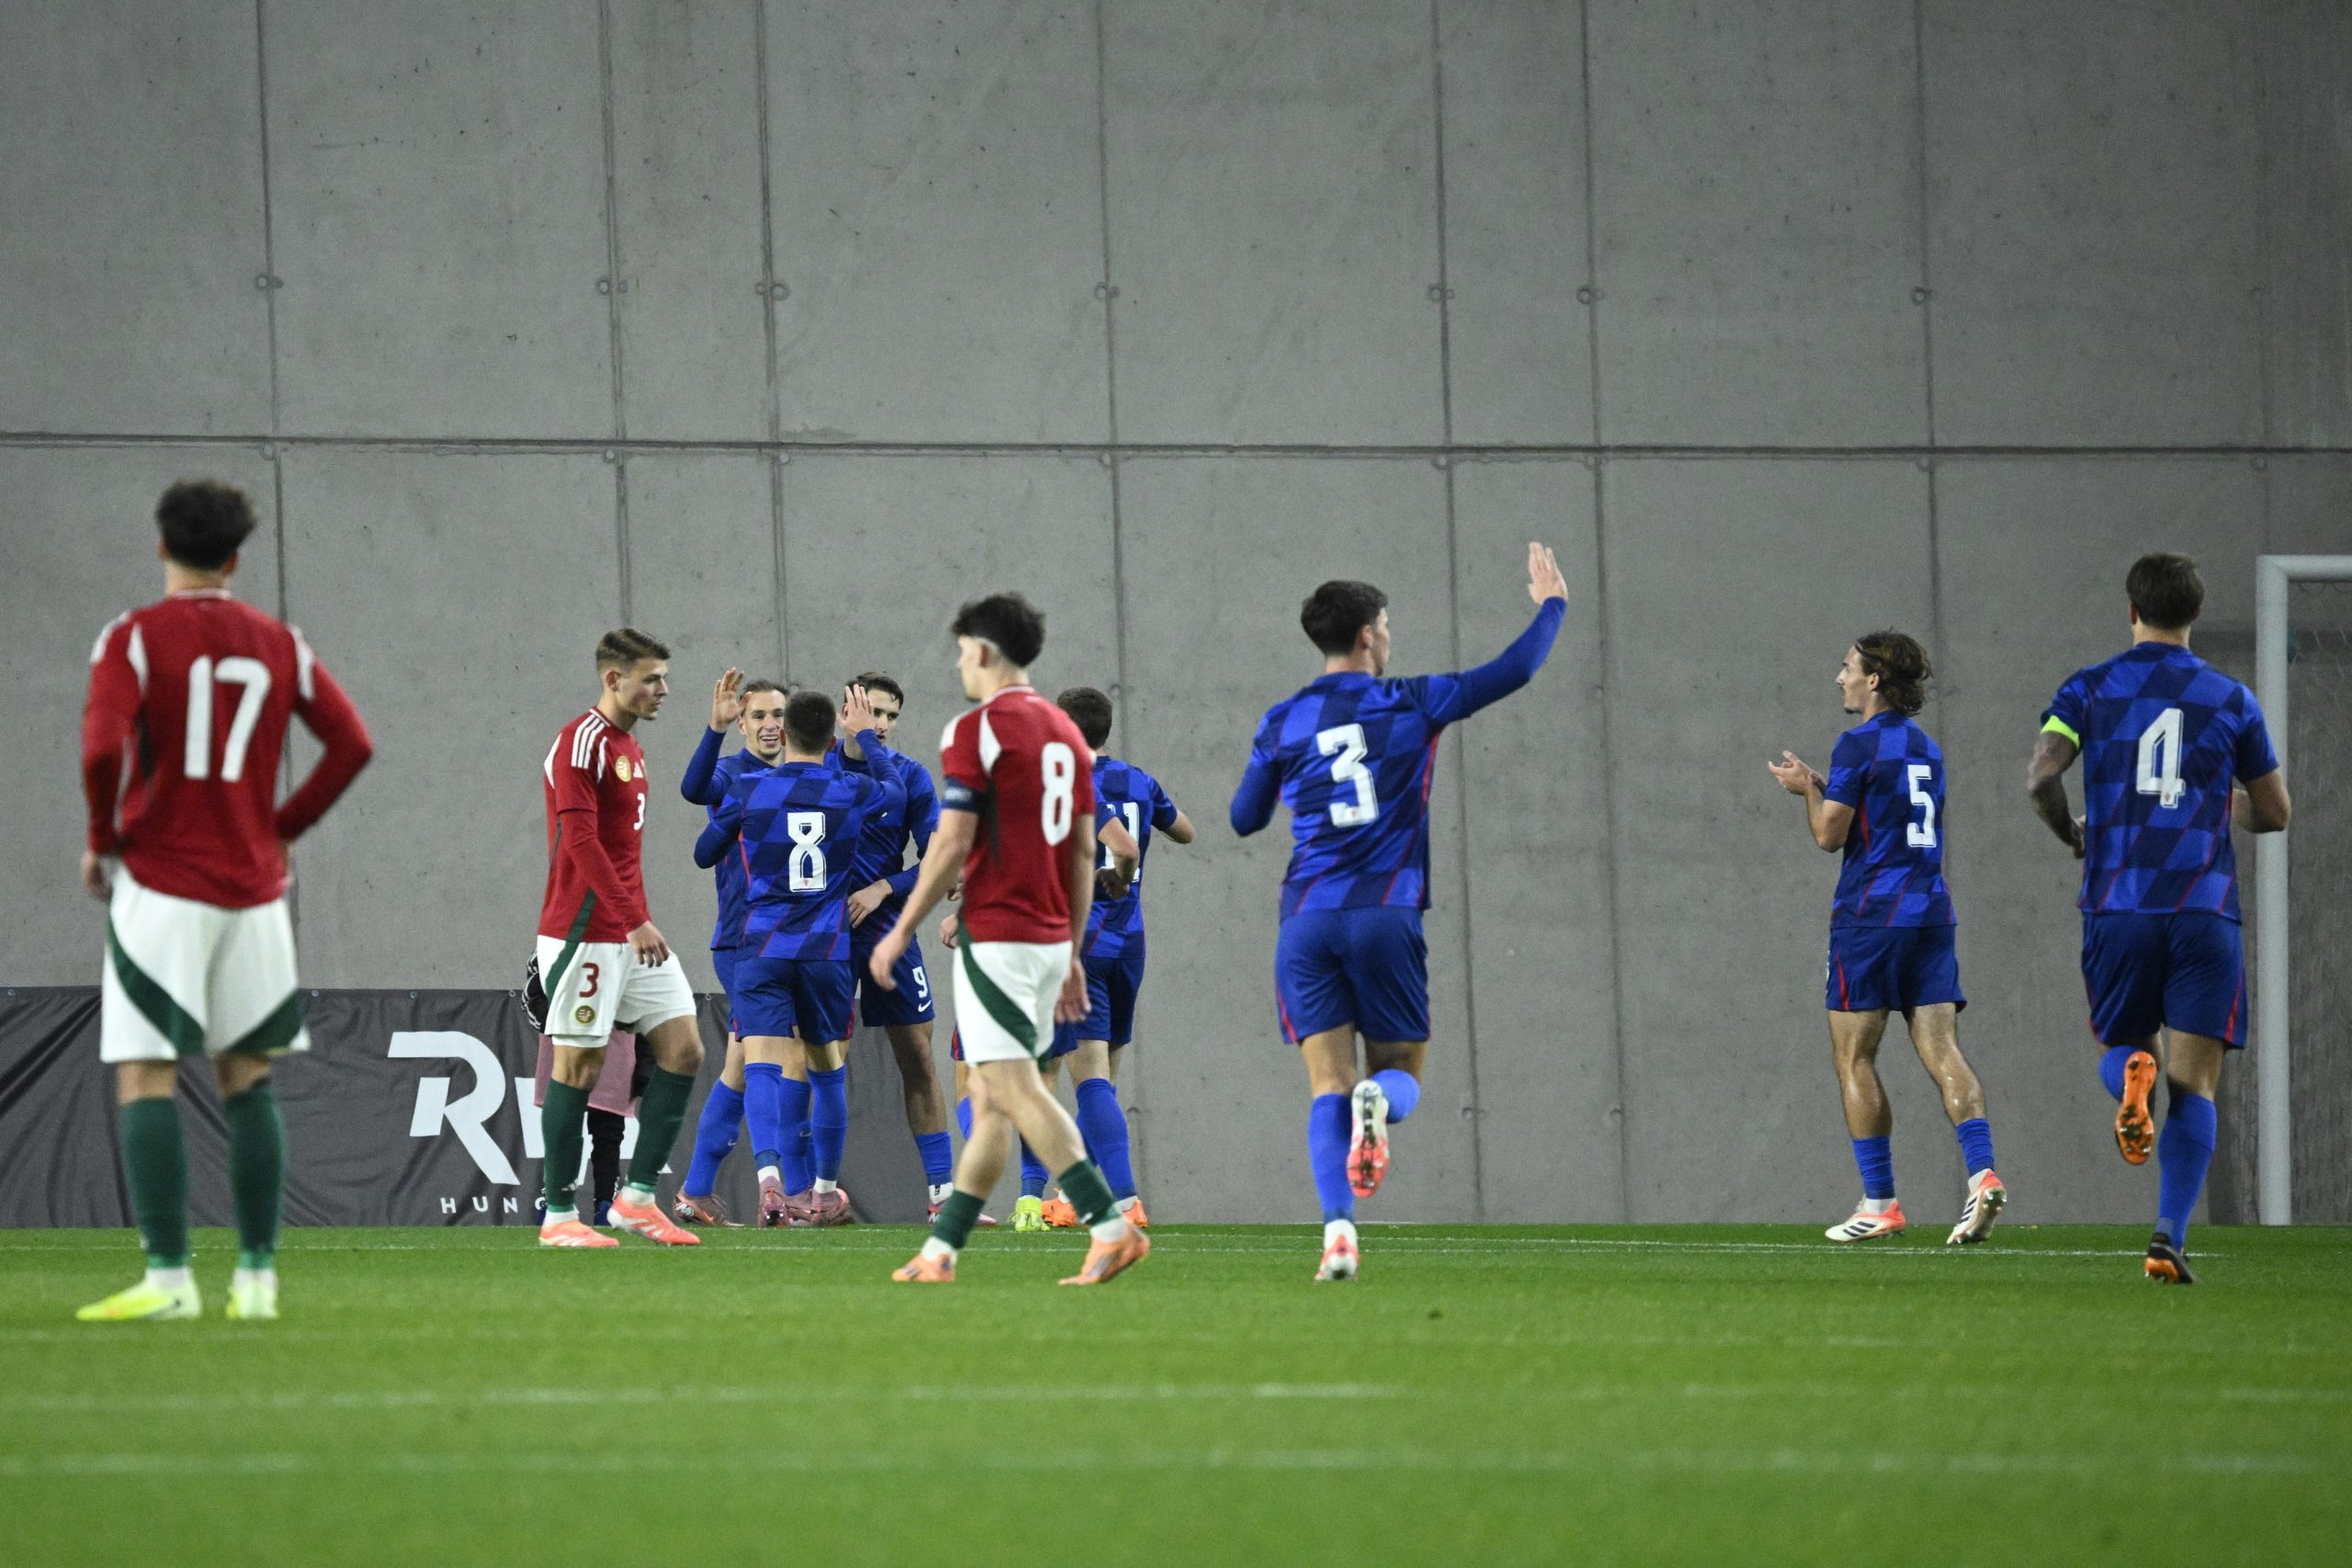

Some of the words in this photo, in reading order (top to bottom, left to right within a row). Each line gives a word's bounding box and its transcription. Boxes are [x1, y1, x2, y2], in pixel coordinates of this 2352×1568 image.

[185, 655, 272, 783] 17
[2136, 707, 2186, 809] 4
[1041, 741, 1076, 846] 8
[1317, 723, 1379, 828] 3
[1907, 764, 1937, 848] 5
[787, 811, 827, 893] 8
[579, 962, 600, 998] 3
[911, 965, 928, 999] 9
